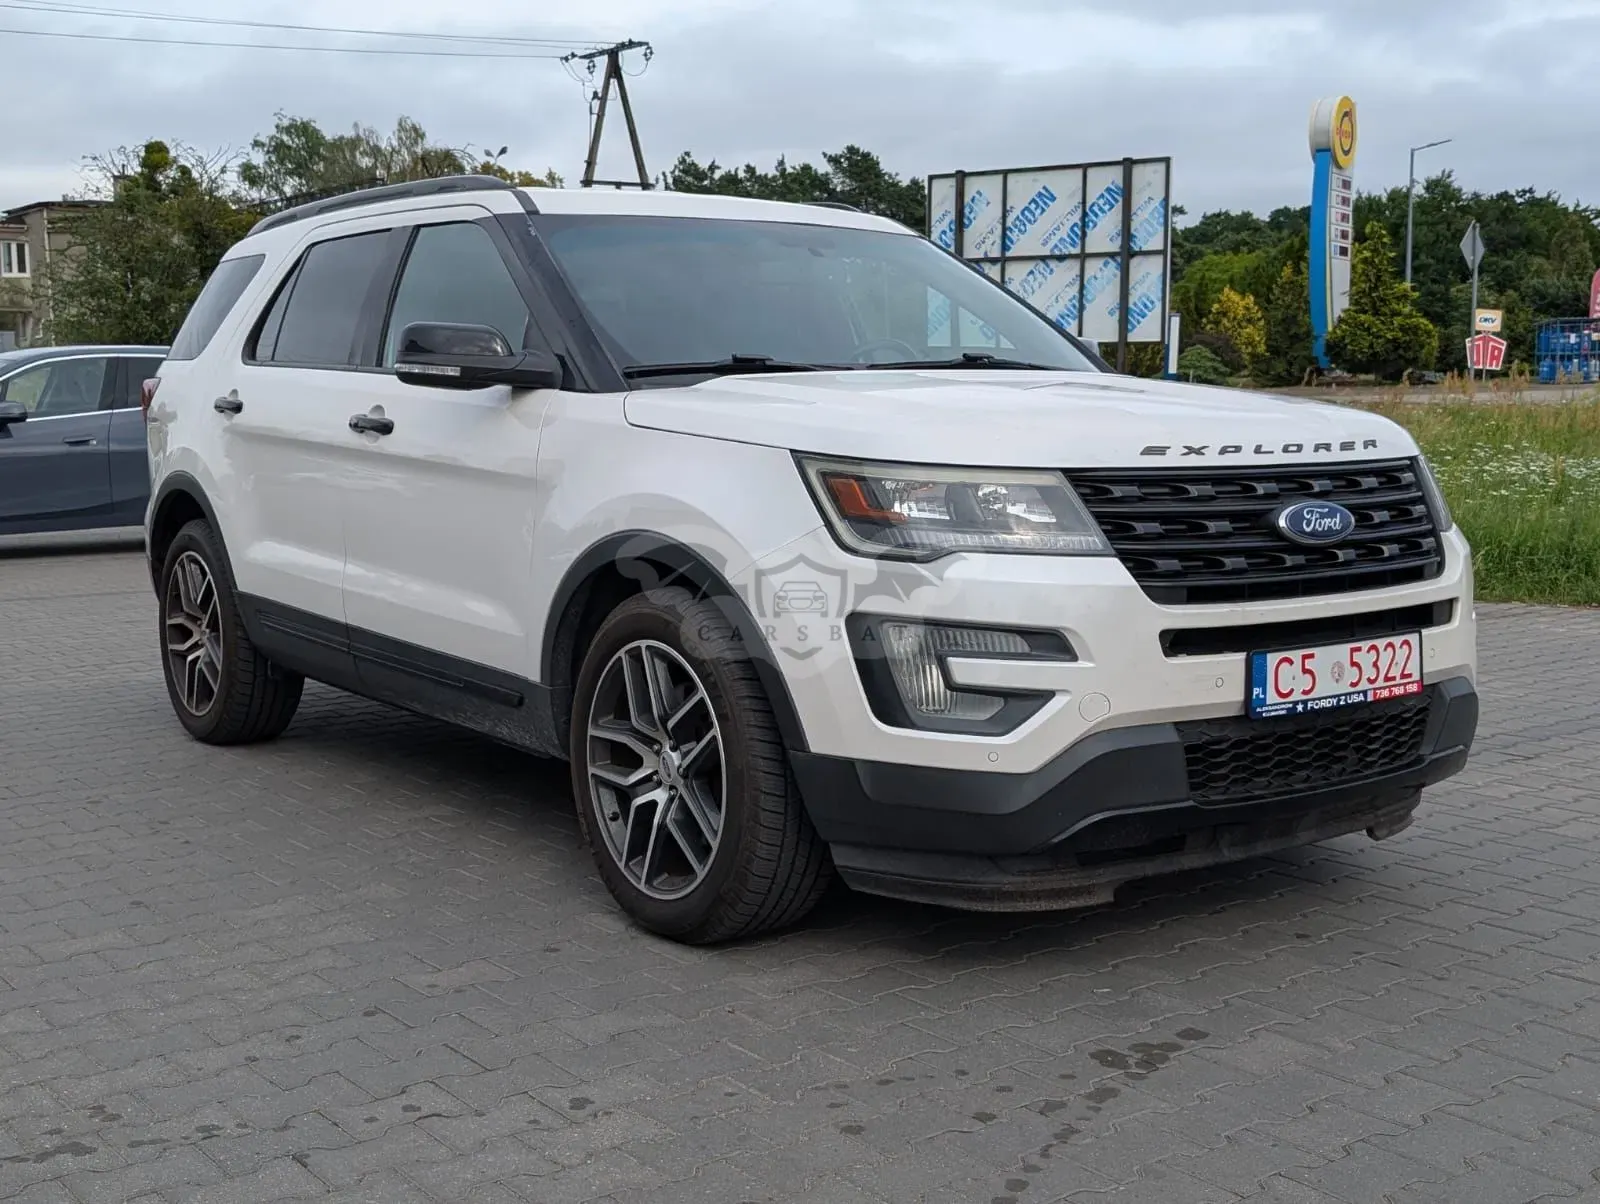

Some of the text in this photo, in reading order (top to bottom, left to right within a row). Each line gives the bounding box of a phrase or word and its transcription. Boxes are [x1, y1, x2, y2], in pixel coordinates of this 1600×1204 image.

[1140, 439, 1378, 456] EXPLORER
[1302, 507, 1343, 532] Ford
[1273, 638, 1414, 700] C5 5322
[1252, 686, 1265, 699] PL
[1307, 692, 1365, 710] FORDY Z USA
